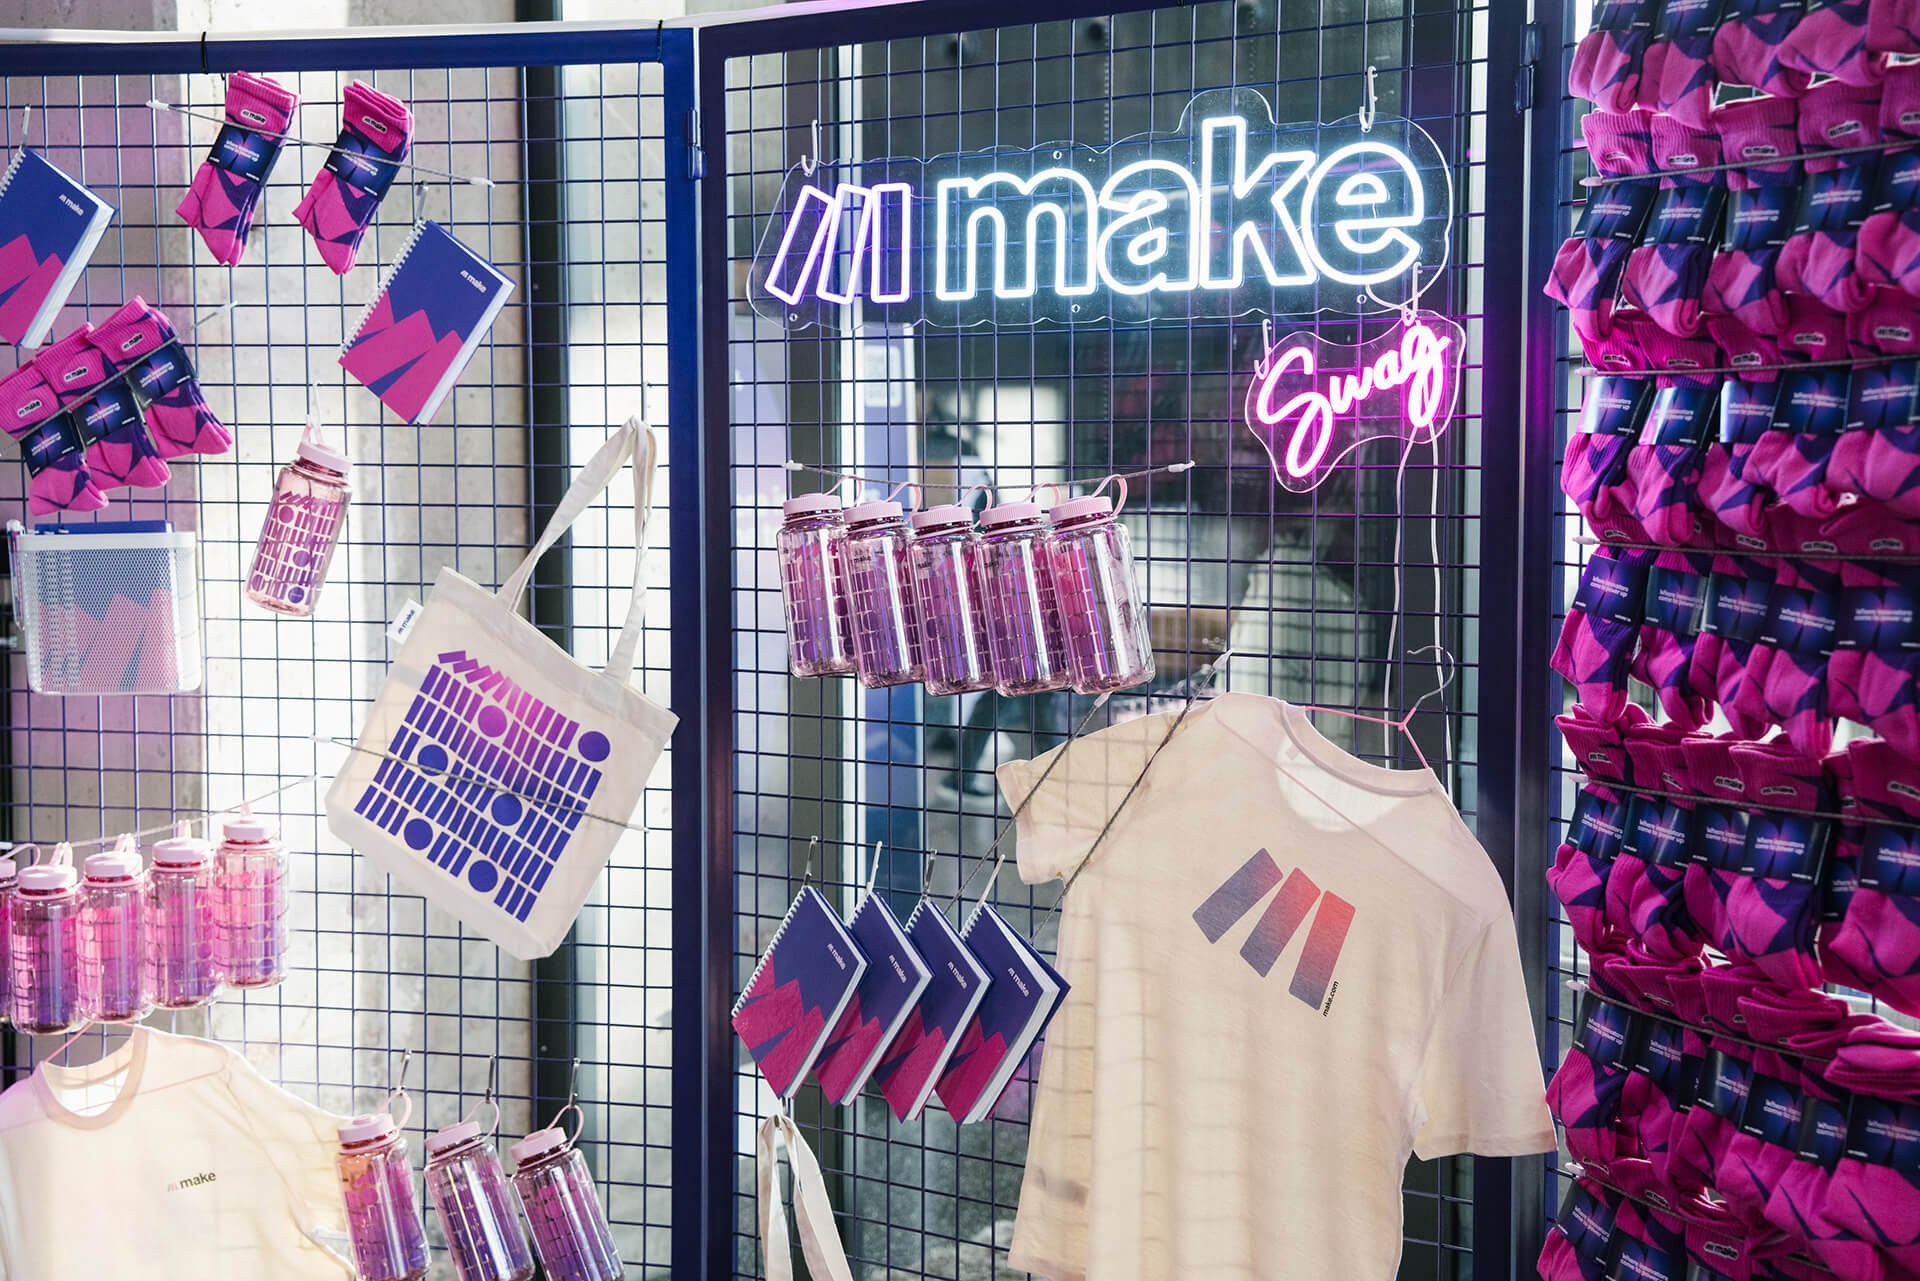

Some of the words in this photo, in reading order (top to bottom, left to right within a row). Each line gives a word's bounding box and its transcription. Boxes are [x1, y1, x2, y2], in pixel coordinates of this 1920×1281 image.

[936, 116, 1425, 300] make
[1255, 321, 1452, 478] Swag
[1322, 980, 1340, 1018] make.com
[180, 1172, 217, 1189] make
